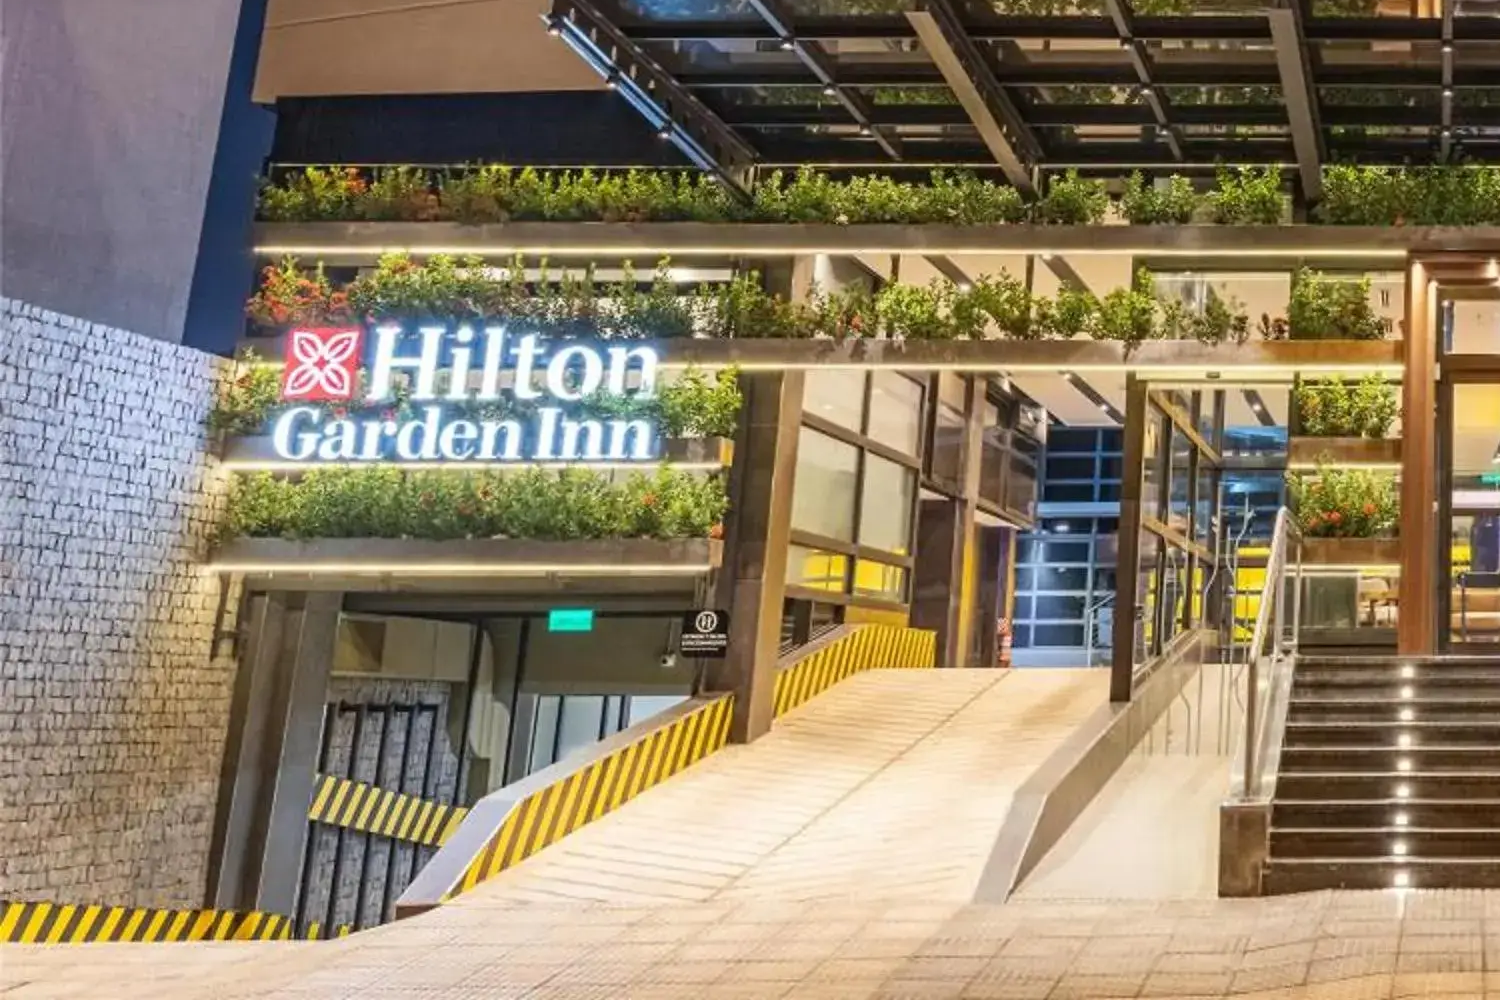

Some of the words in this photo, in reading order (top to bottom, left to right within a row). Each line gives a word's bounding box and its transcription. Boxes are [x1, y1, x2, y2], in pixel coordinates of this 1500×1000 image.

[366, 324, 660, 401] Hilton
[273, 406, 523, 460] Garden
[531, 406, 655, 460] Inn
